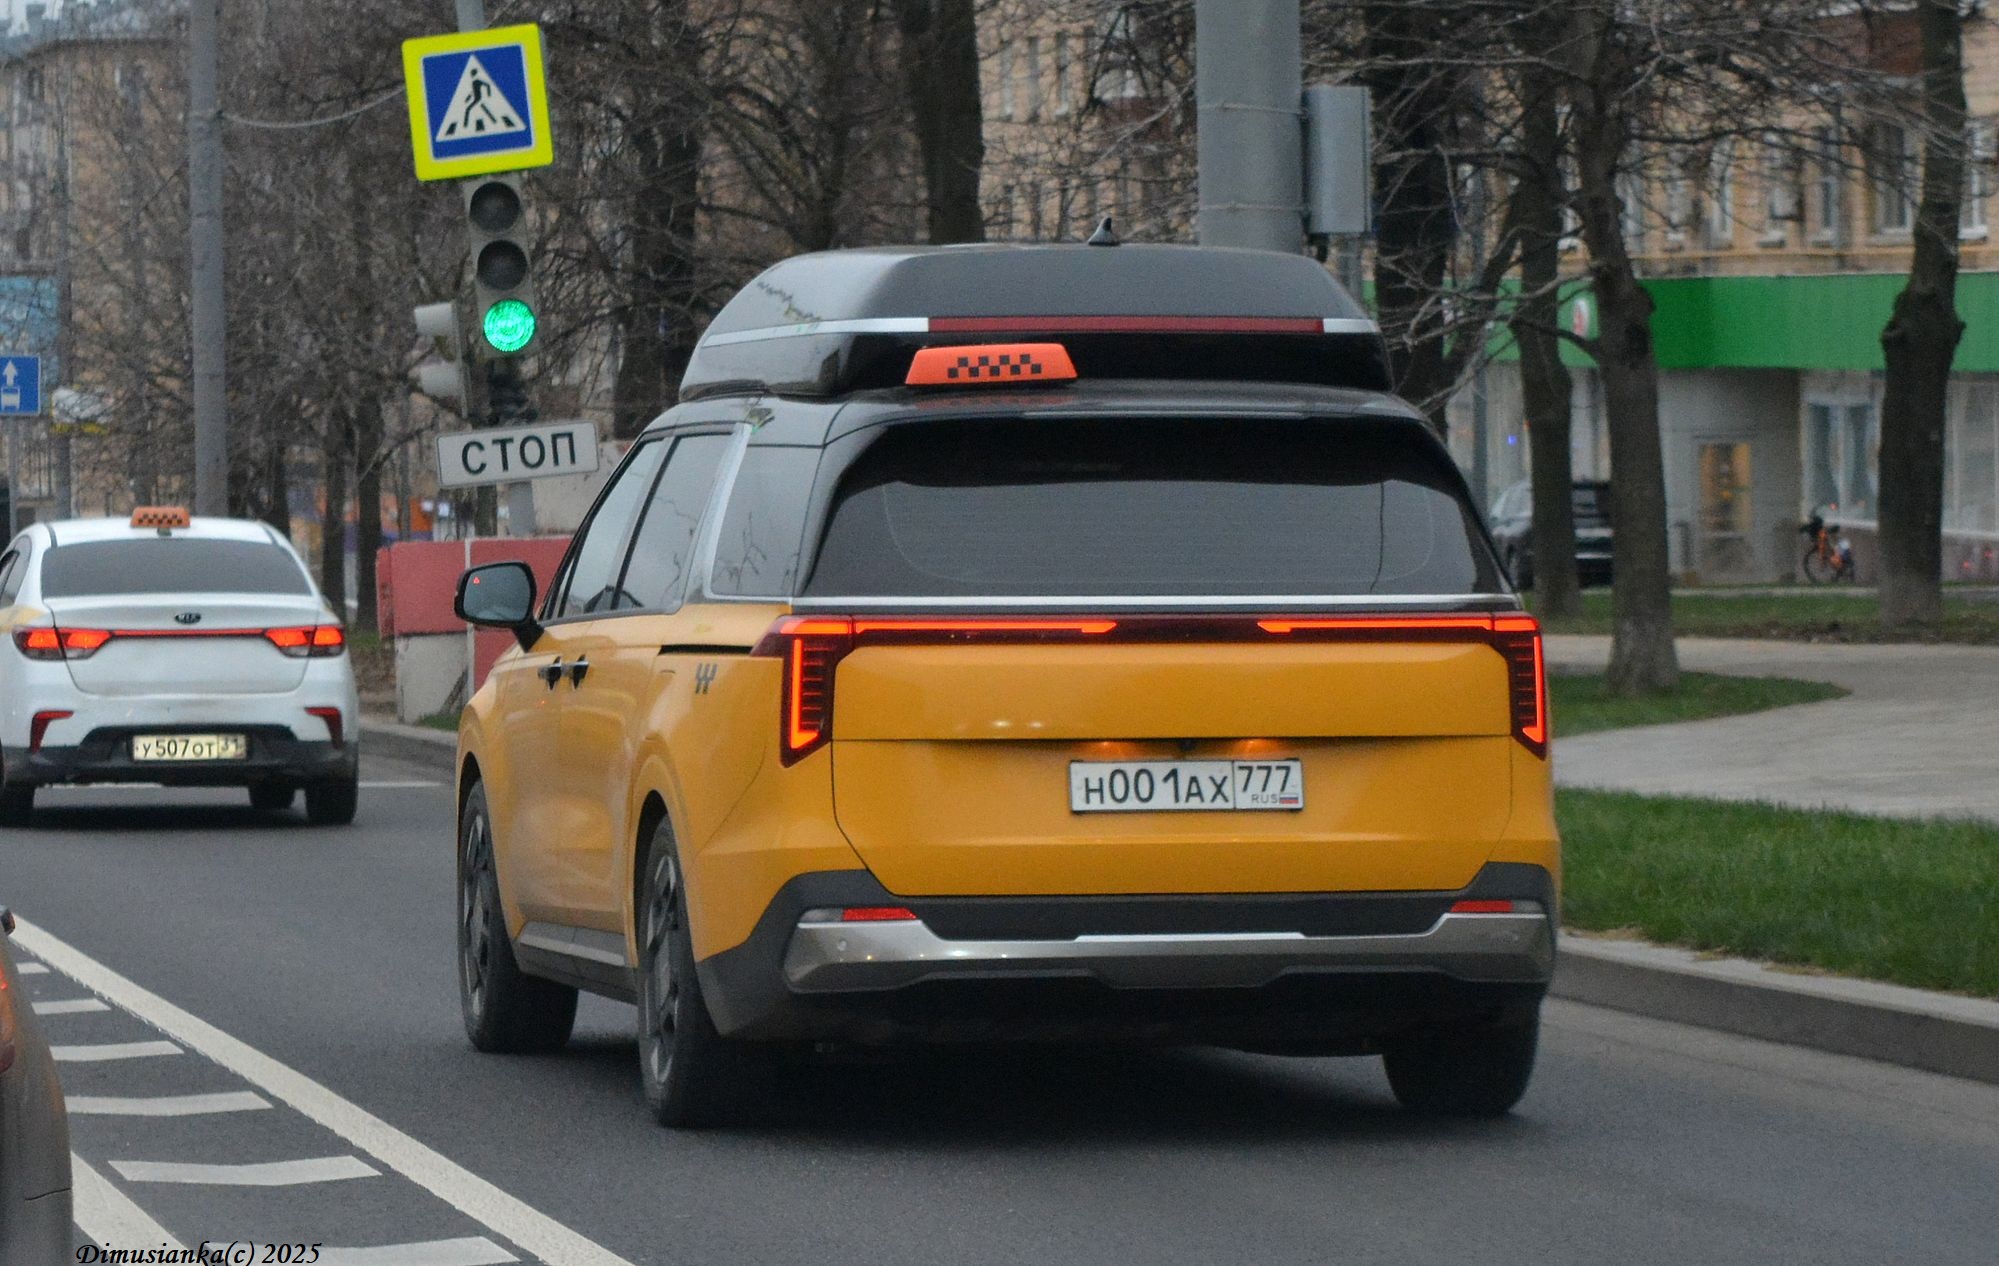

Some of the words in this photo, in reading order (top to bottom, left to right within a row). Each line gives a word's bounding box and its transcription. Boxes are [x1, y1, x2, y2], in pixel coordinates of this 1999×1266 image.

[461, 431, 576, 475] СТОП
[1084, 767, 1230, 805] Н001АХ
[1237, 765, 1292, 793] 777
[1251, 793, 1279, 805] RUS
